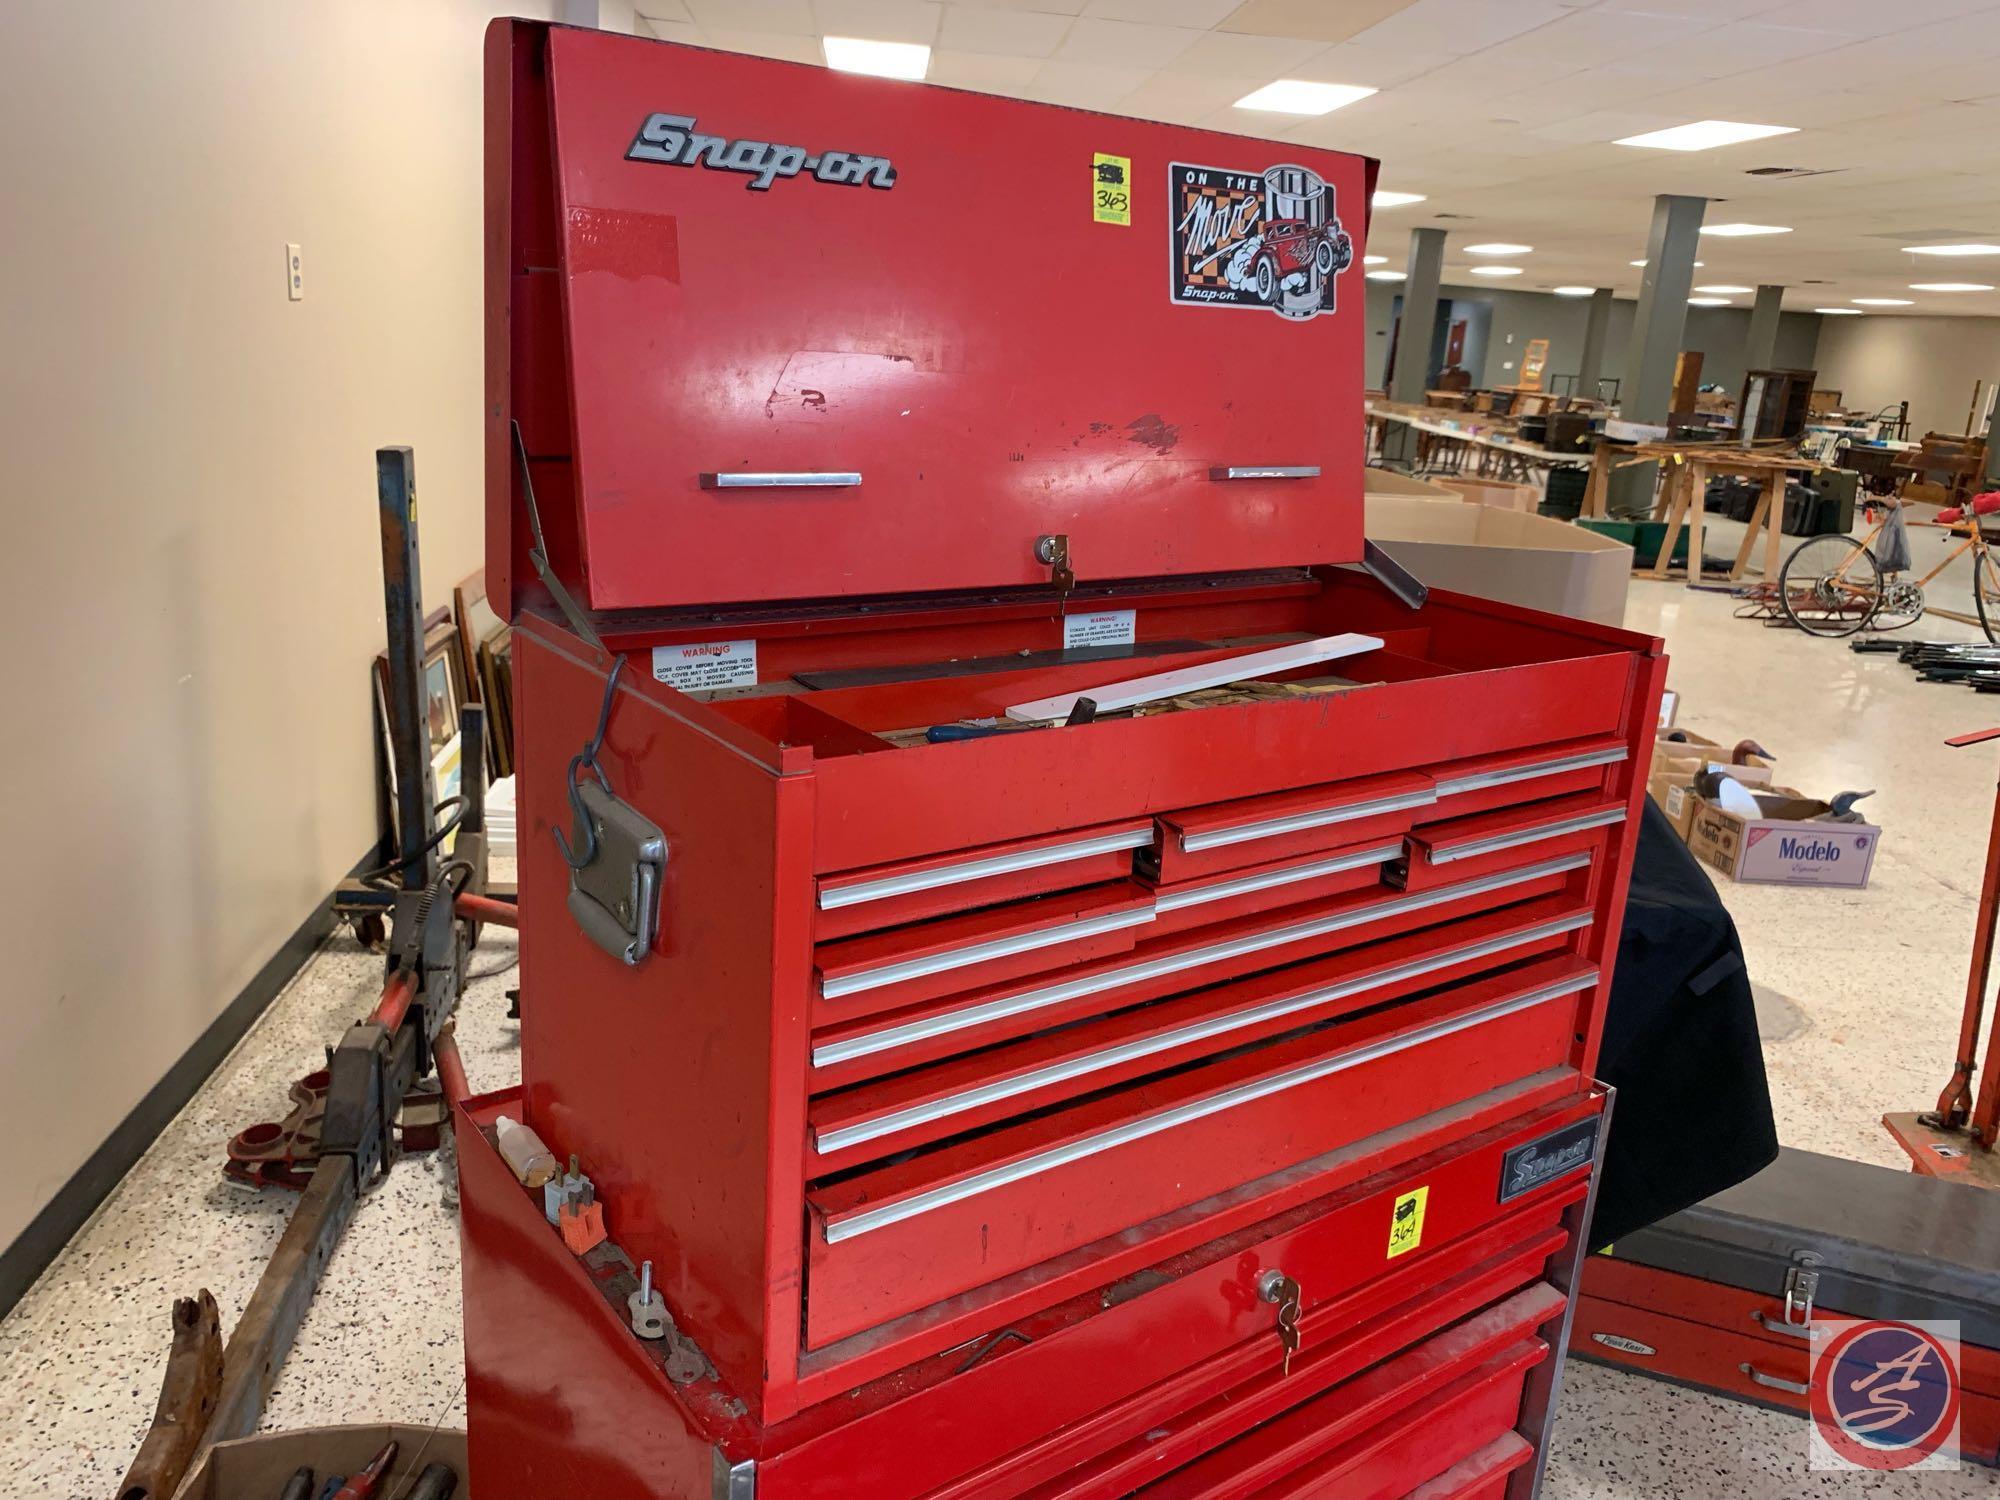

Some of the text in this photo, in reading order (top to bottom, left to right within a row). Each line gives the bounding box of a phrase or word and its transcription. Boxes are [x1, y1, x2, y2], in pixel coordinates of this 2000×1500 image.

[625, 112, 897, 190] Snap-on
[1185, 171, 1258, 191] ON THE
[1096, 190, 1128, 211] 363
[1177, 195, 1261, 256] Move
[1182, 285, 1237, 301] Snap-on
[682, 645, 731, 657] WARNING
[730, 670, 754, 678] CAUSING
[1778, 837, 1841, 861] Modelo
[1390, 1219, 1416, 1246] 364
